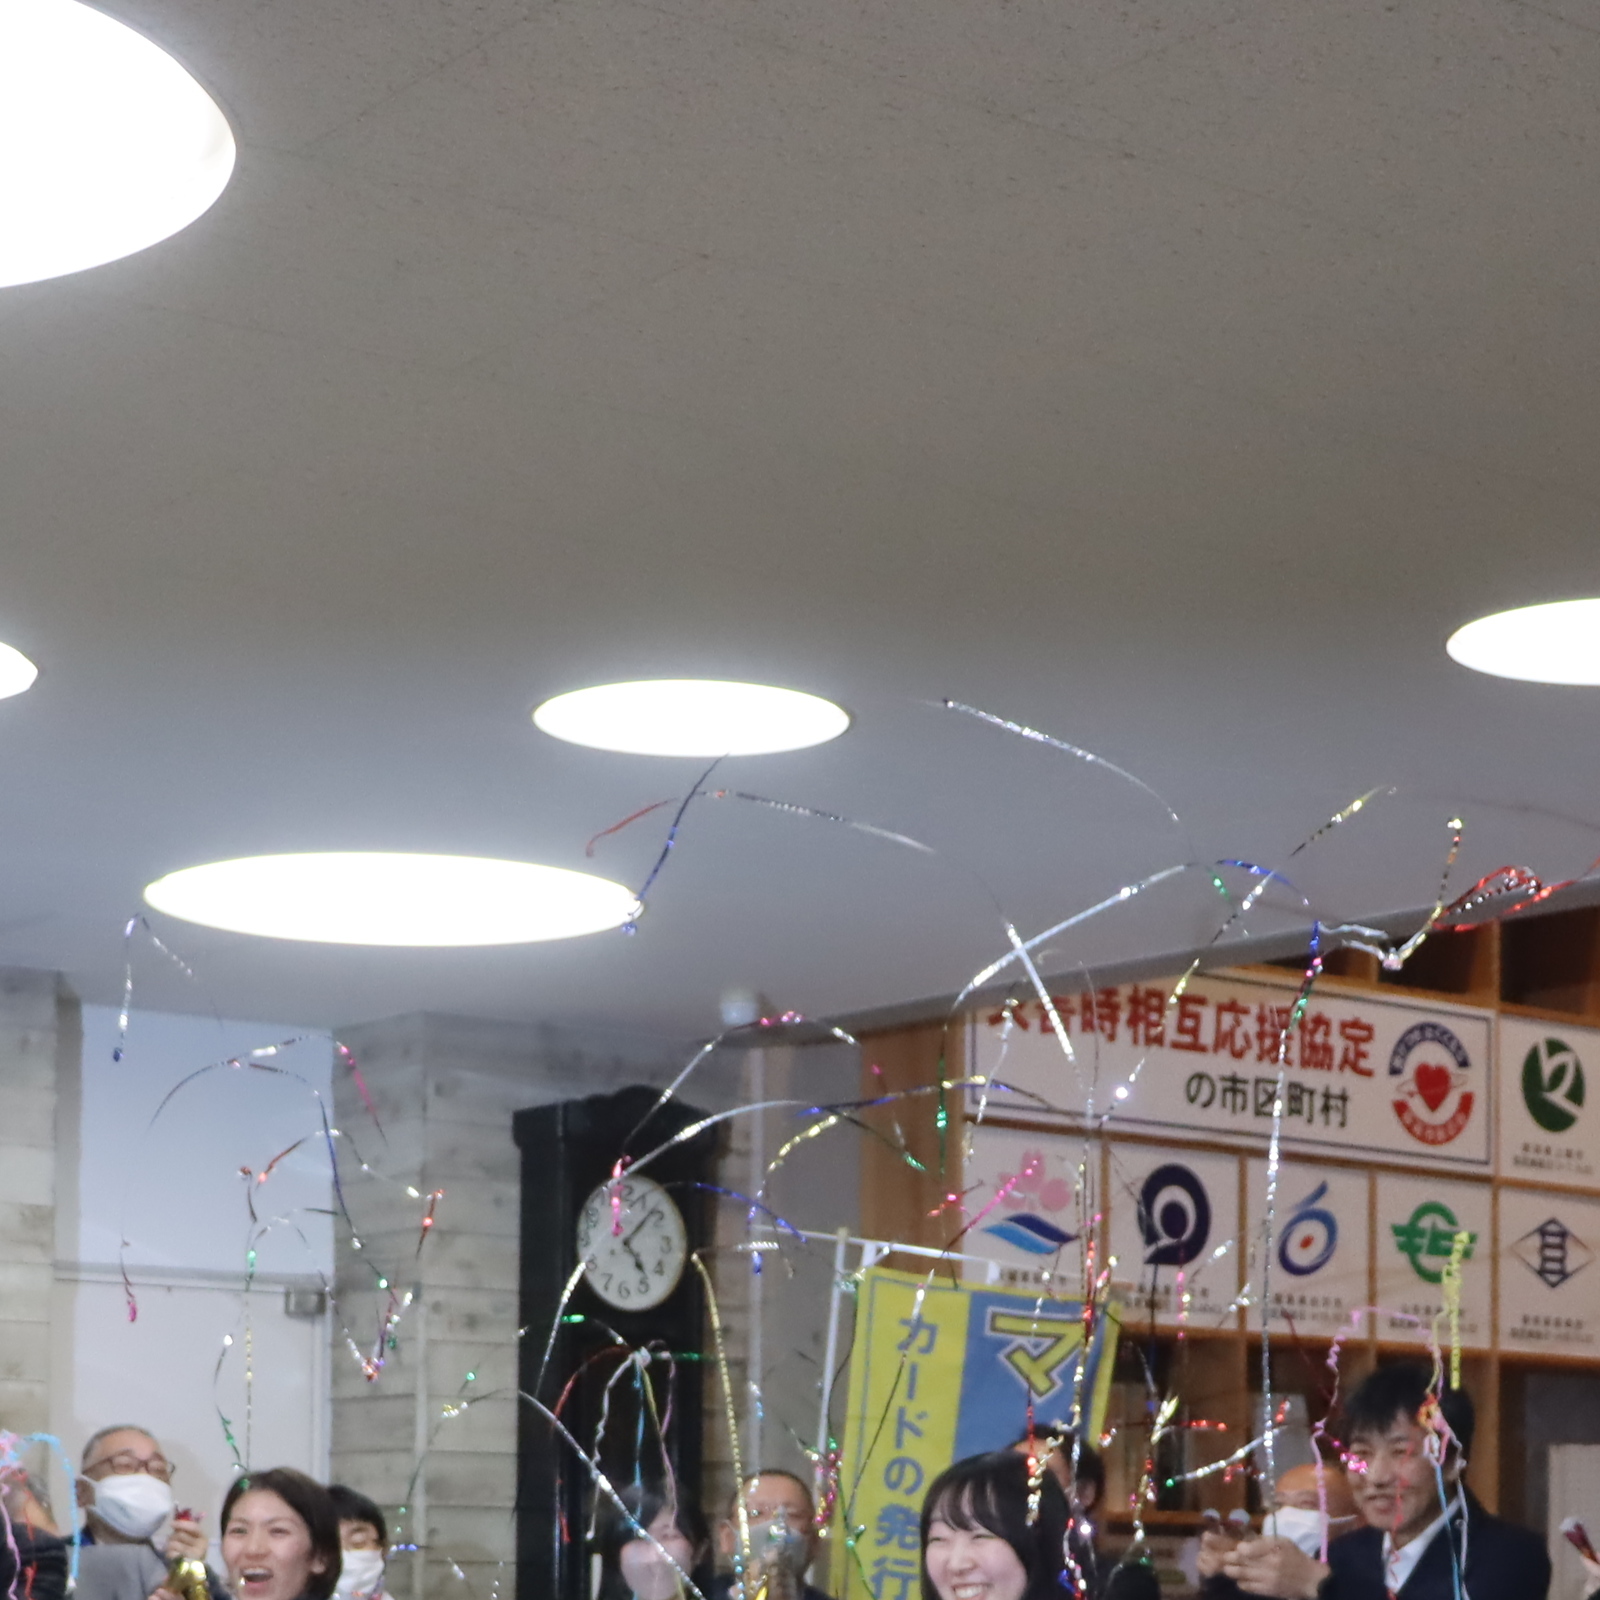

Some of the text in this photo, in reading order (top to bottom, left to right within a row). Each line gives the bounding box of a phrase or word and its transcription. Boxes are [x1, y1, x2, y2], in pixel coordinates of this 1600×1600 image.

[1186, 1070, 1351, 1129] の市区町村
